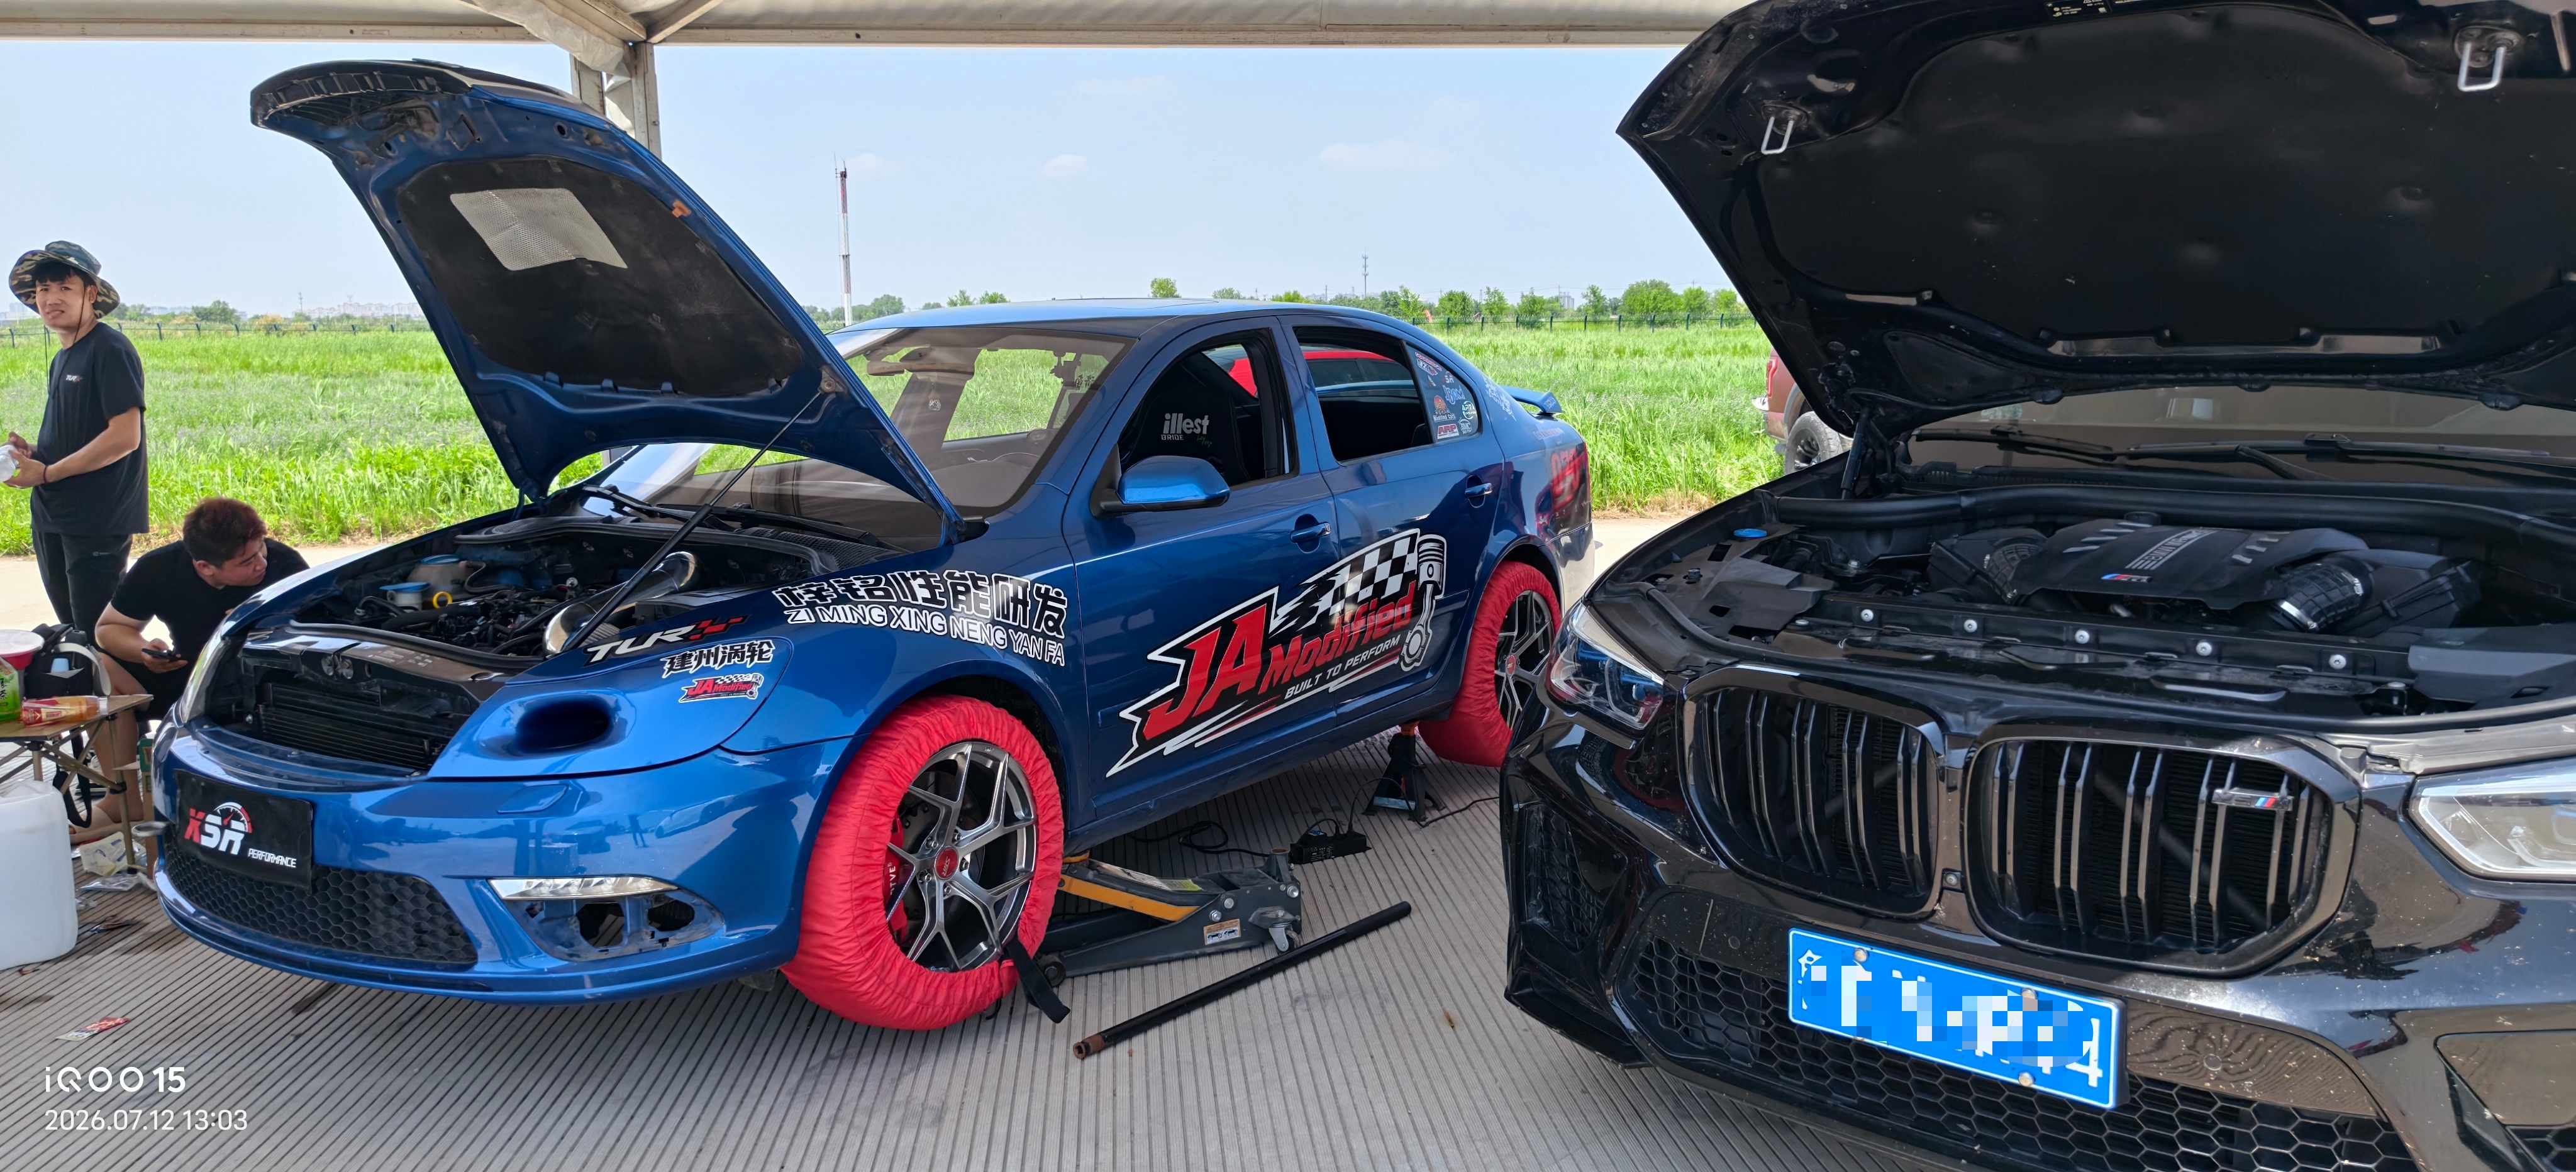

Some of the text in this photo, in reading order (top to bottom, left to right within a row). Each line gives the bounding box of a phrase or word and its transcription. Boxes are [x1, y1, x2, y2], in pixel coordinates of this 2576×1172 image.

[1163, 412, 1209, 434] illest
[1438, 424, 1457, 434] ARP
[772, 570, 1067, 639] 梓铭性能研发
[784, 604, 1065, 666] ZI MING XING NENG YAN FA
[662, 641, 775, 678] 建州涡轮
[1143, 580, 1417, 740] JA Modified
[1284, 634, 1401, 700] BUILT TO PERFORM
[687, 678, 715, 695] JA
[248, 848, 297, 868] PERFORMANCE
